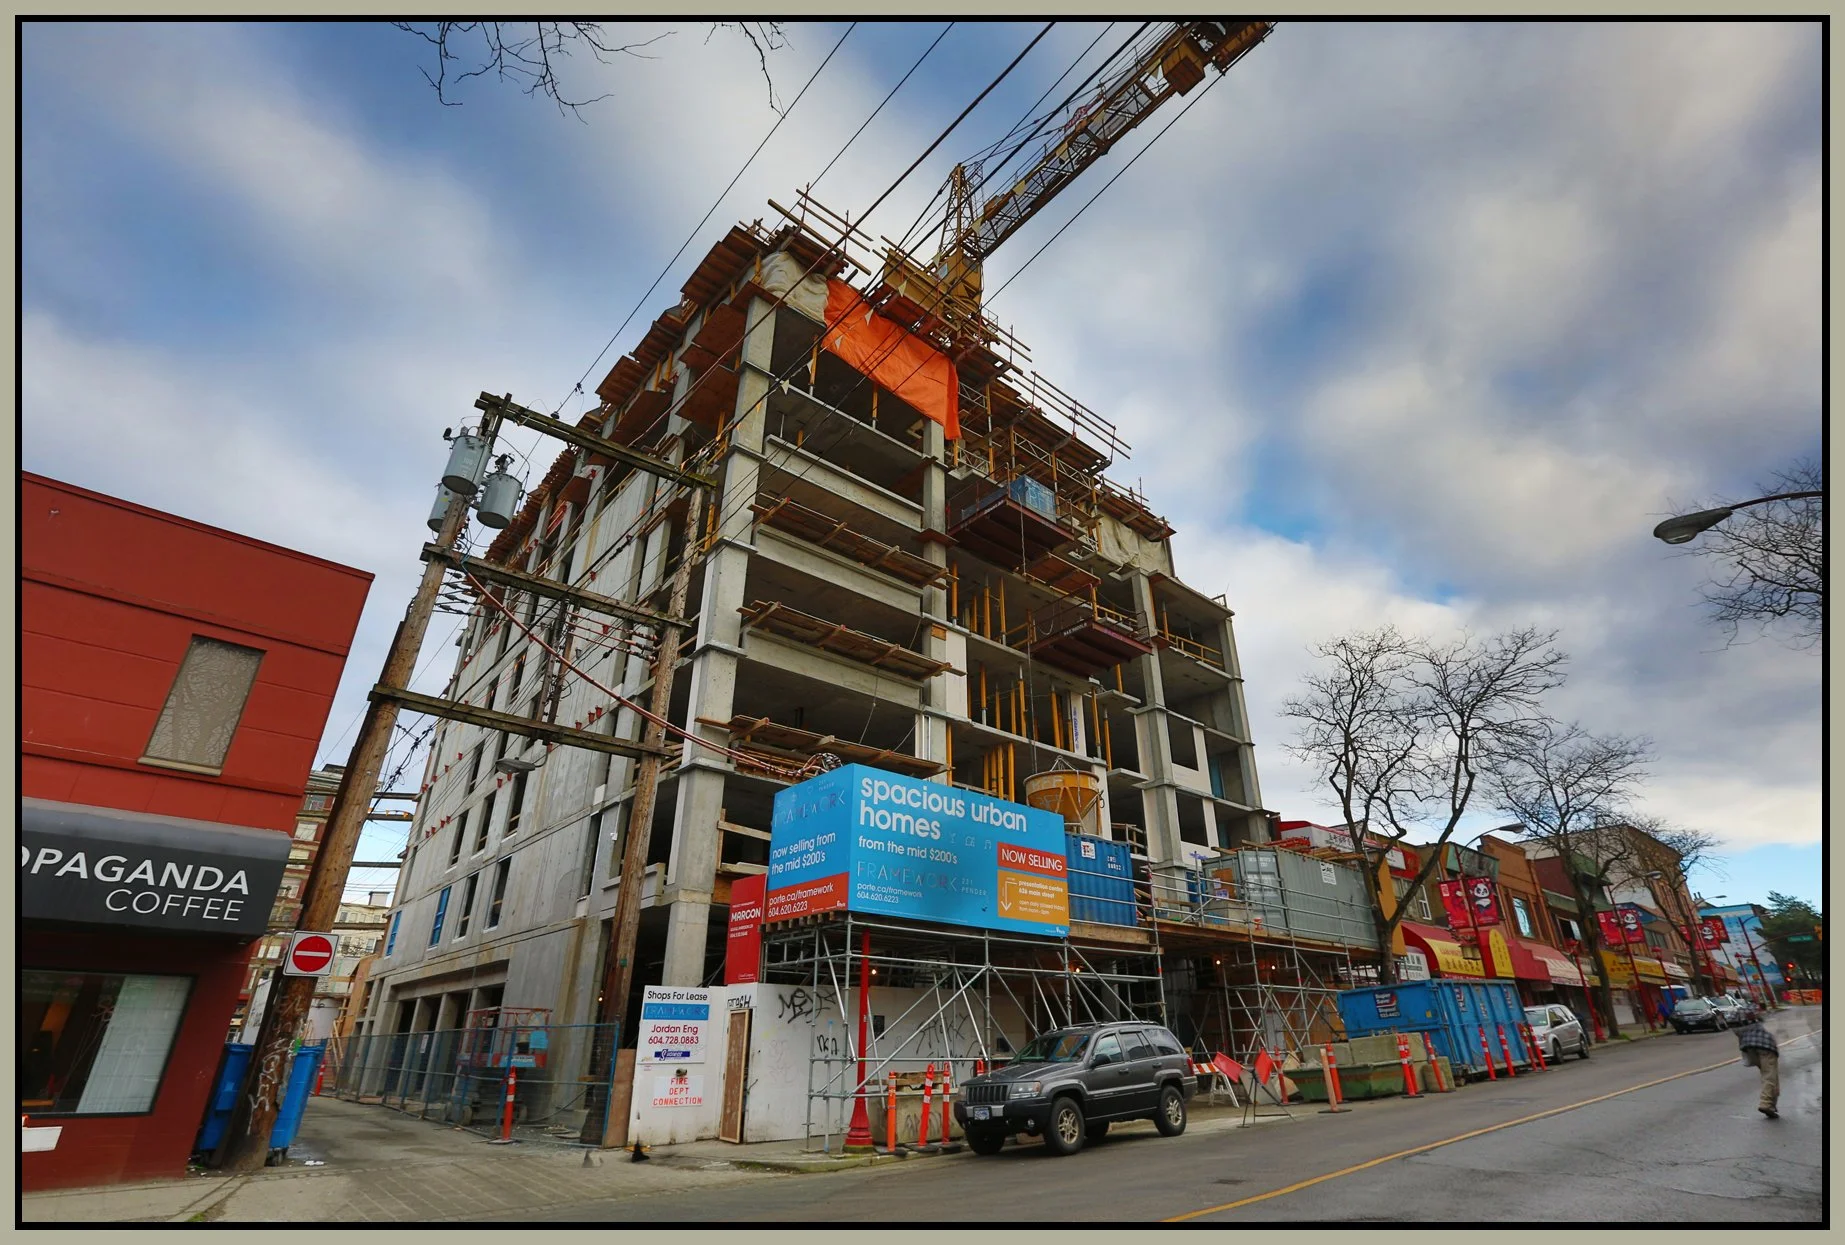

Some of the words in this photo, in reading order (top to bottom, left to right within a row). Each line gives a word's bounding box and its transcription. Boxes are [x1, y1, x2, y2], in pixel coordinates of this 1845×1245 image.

[861, 777, 965, 818] spacious
[971, 802, 1027, 833] urban
[860, 800, 941, 840] homes
[772, 845, 787, 859] now
[789, 837, 815, 854] selling
[816, 832, 836, 847] from
[858, 836, 885, 851] from
[887, 841, 905, 854] the
[907, 846, 927, 858] mid
[929, 848, 957, 864] $200's
[771, 860, 784, 875] the
[785, 856, 801, 871] mid
[801, 850, 826, 869] $200's
[1001, 848, 1027, 865] NOW
[1028, 854, 1063, 871] SELLING
[22, 845, 249, 895] PAGANDA
[857, 860, 957, 892] FRAMEWORK
[768, 883, 834, 906] porte.ca/framework
[856, 892, 899, 904] 604.620.6223
[857, 883, 922, 898] porte.ca/framework
[961, 886, 987, 896] PENDER
[105, 889, 245, 921] COFFEE
[768, 901, 808, 918] 604.620.6223
[730, 907, 762, 923] MARCON
[647, 991, 671, 1001] Shops
[672, 991, 685, 1000] For
[686, 992, 708, 1001] Lease
[651, 1025, 681, 1034] Jordan
[682, 1025, 699, 1035] Eng
[648, 1036, 699, 1045] 604.728.0883
[670, 1077, 689, 1085] FIRE
[669, 1087, 690, 1095] DEPT
[653, 1097, 702, 1105] CONNECTION
